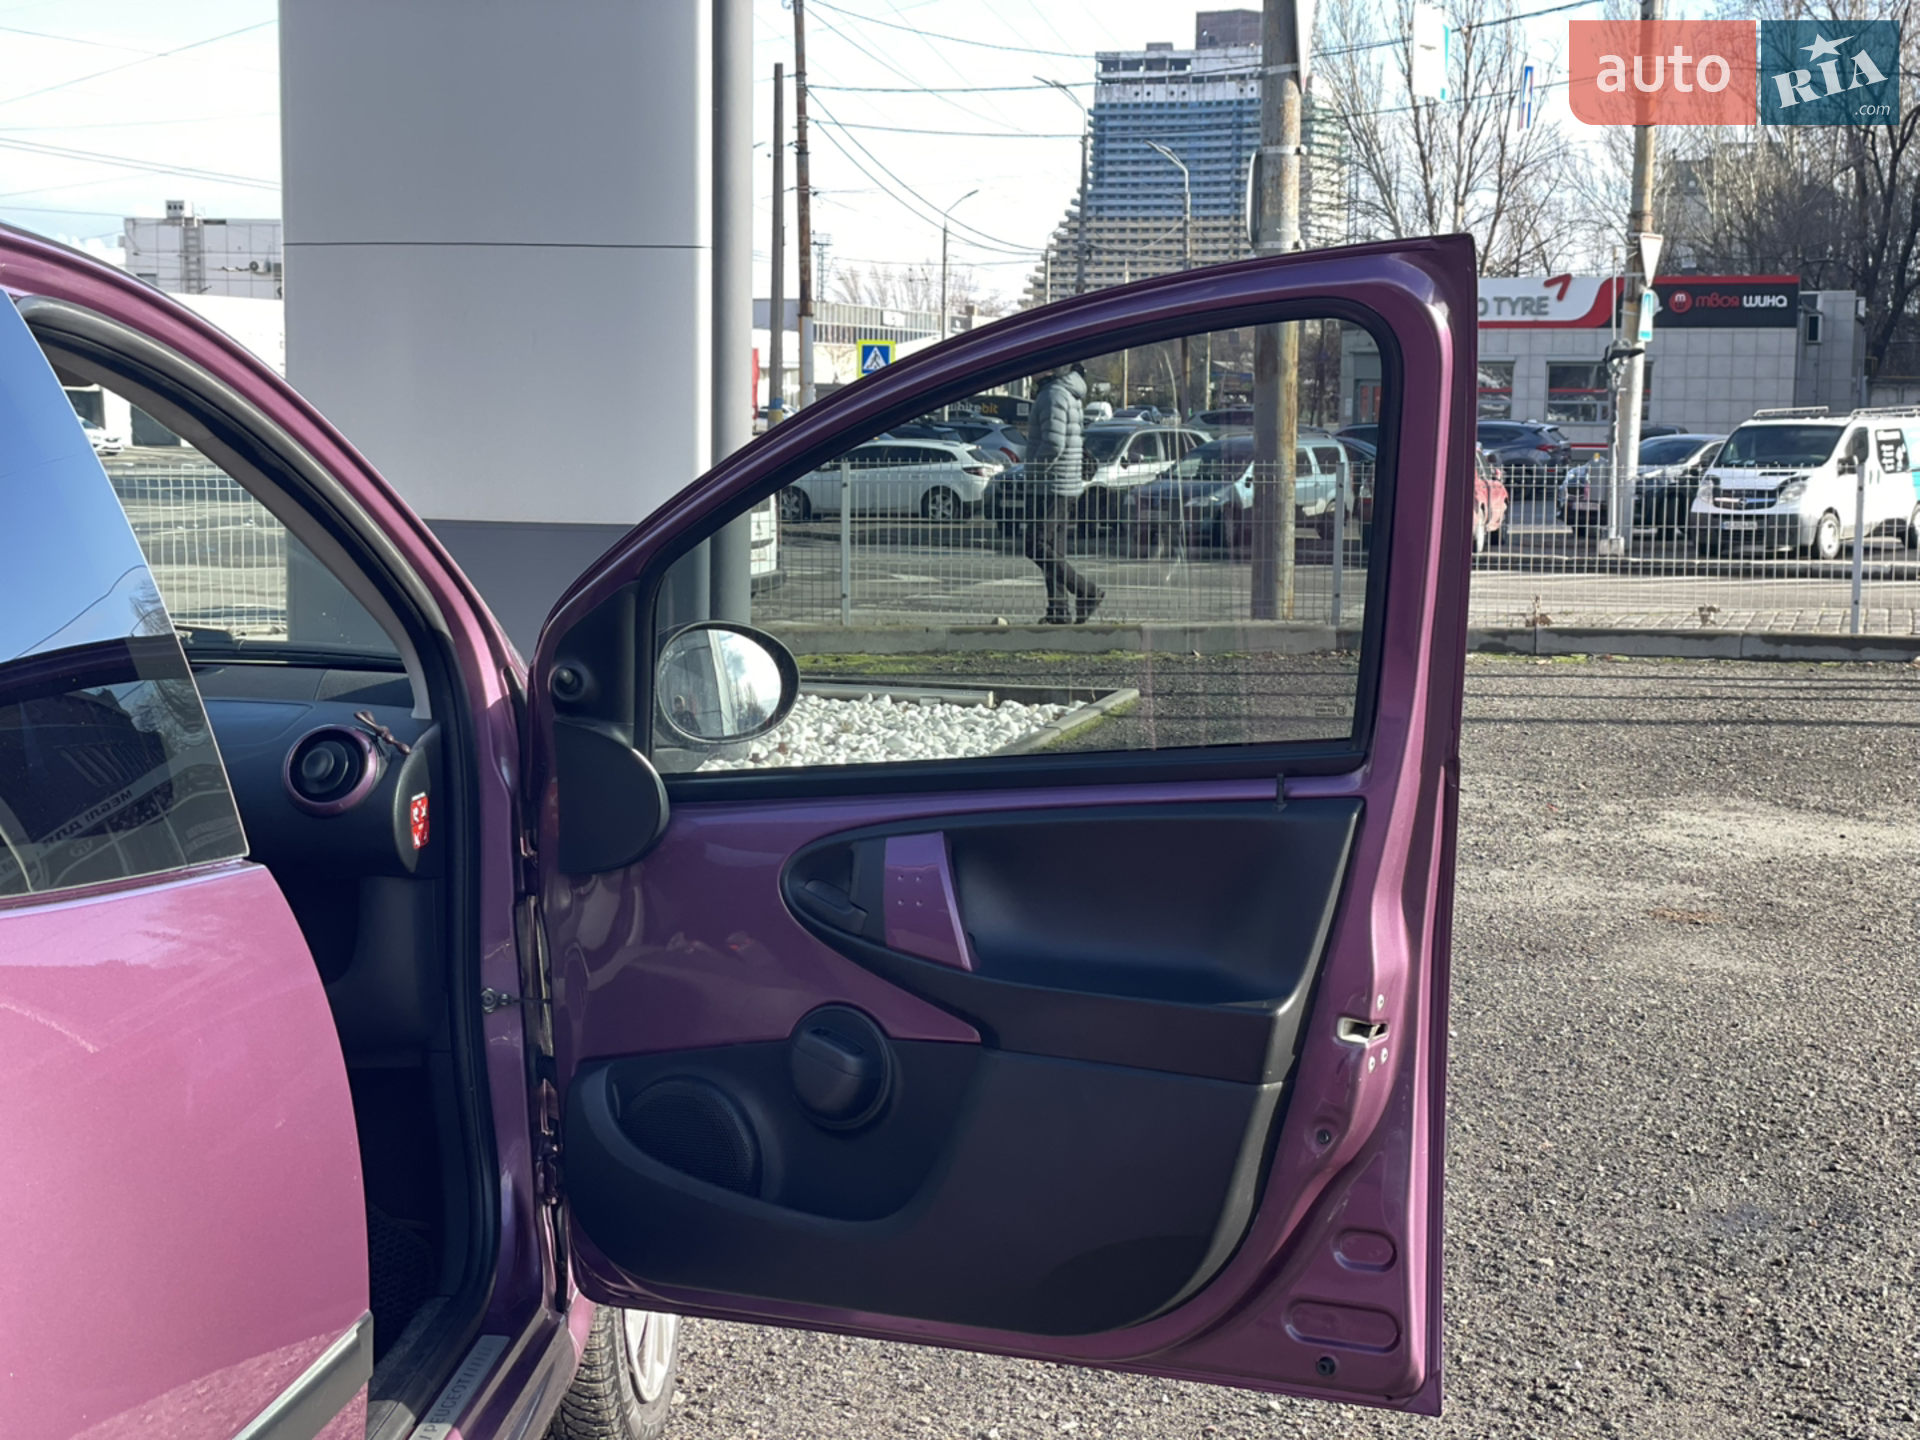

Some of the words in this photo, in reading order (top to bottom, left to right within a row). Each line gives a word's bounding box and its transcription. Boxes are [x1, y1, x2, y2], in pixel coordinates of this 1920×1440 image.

[1493, 296, 1550, 316] TYRE
[1695, 292, 1740, 308] твоя
[1743, 294, 1788, 308] шина
[423, 1377, 473, 1433] PEUGEOT
